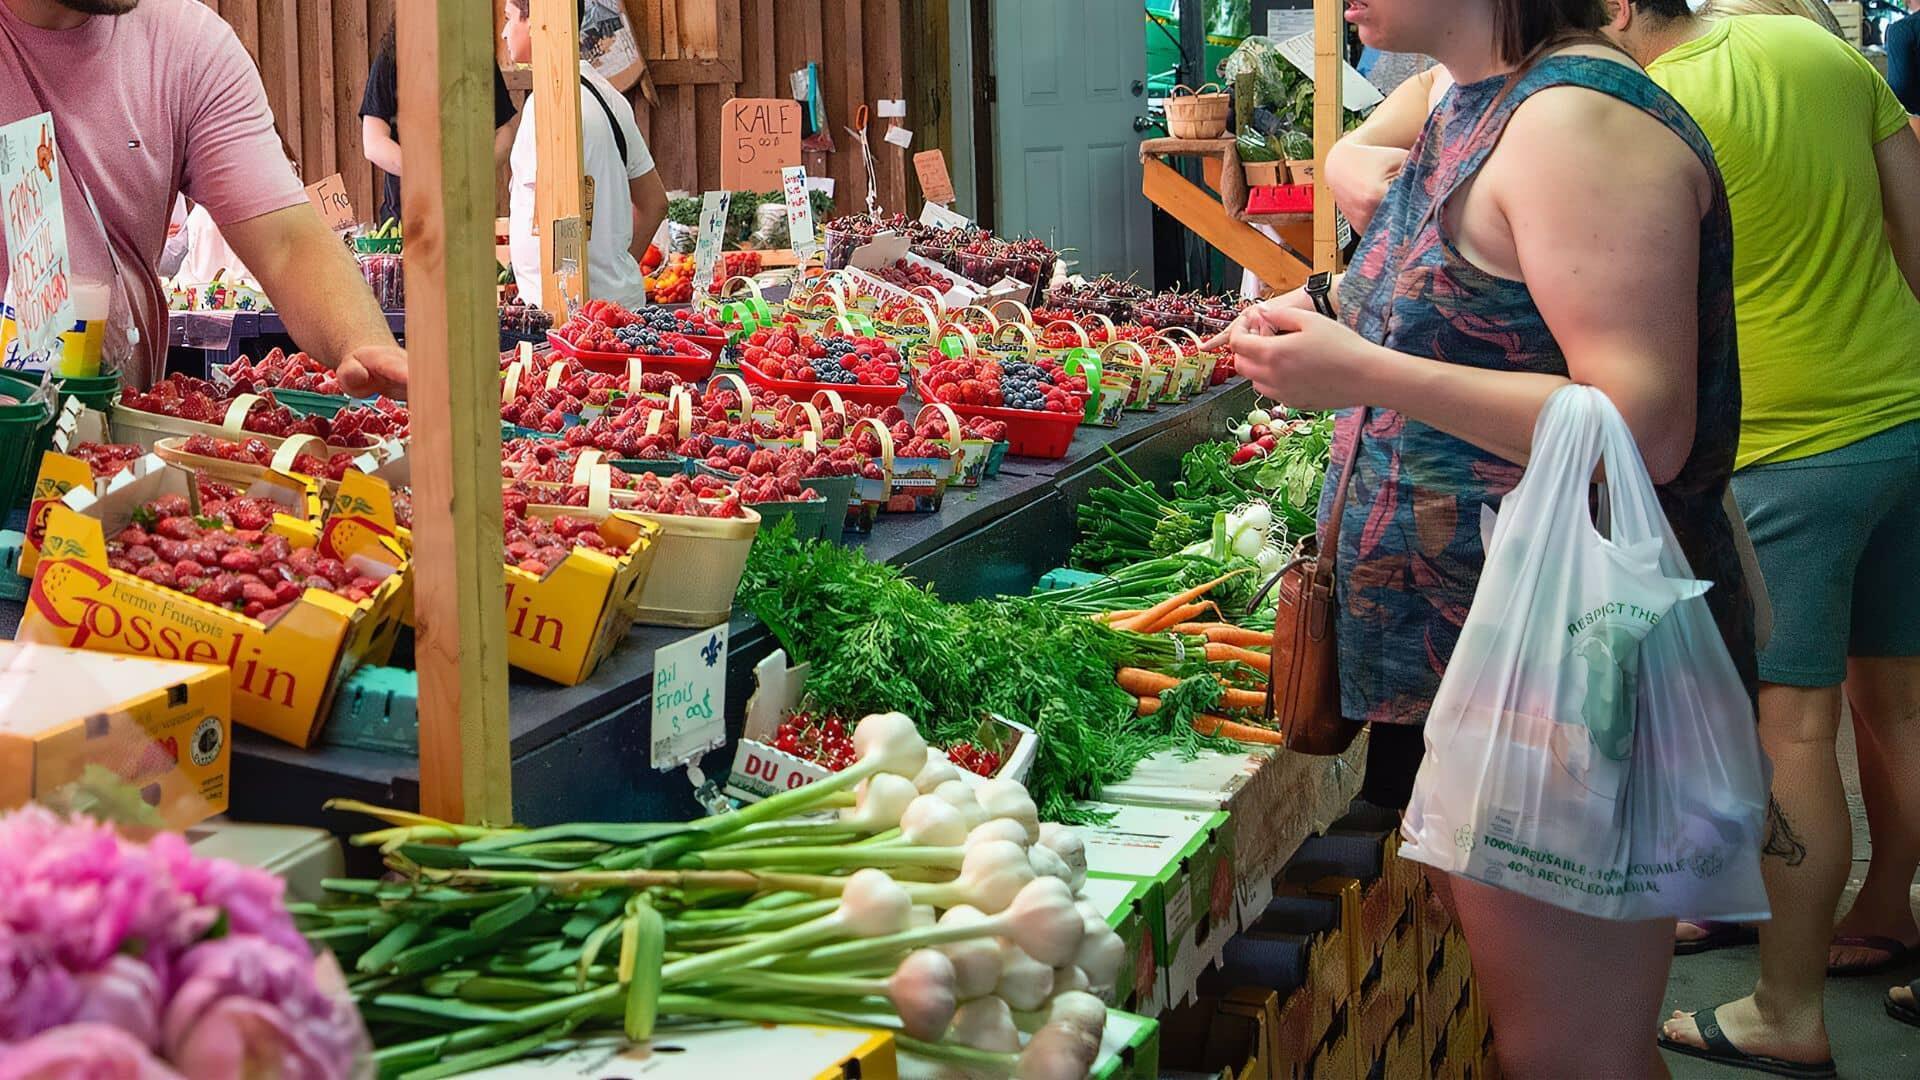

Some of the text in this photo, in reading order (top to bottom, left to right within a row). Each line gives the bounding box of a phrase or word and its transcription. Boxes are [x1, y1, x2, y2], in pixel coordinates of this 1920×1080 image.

[735, 103, 793, 134] KALE
[111, 582, 224, 639] Ferme François
[31, 559, 296, 708] Gosselin
[657, 661, 677, 690] Ail
[744, 753, 778, 782] DU
[1507, 860, 1535, 877] 40%
[1537, 867, 1604, 896] RECYCLED
